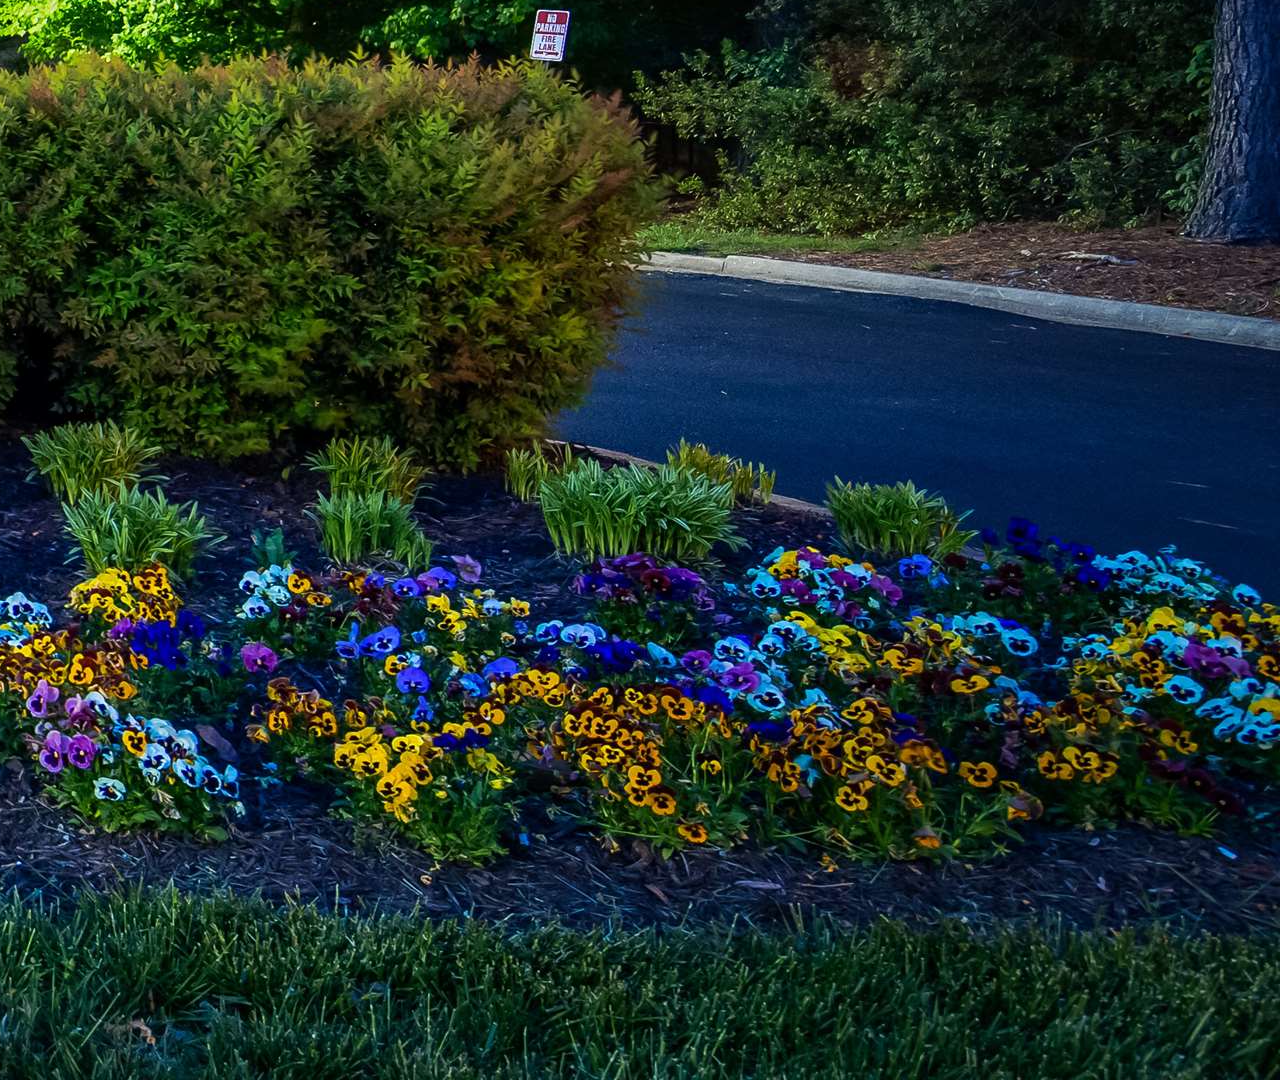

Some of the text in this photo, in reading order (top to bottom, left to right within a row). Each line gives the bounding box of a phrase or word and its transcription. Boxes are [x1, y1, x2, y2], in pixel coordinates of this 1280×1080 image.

[547, 13, 557, 23] NO
[536, 23, 565, 33] PARKING
[541, 35, 556, 43] FIRE
[539, 43, 556, 51] LANE
